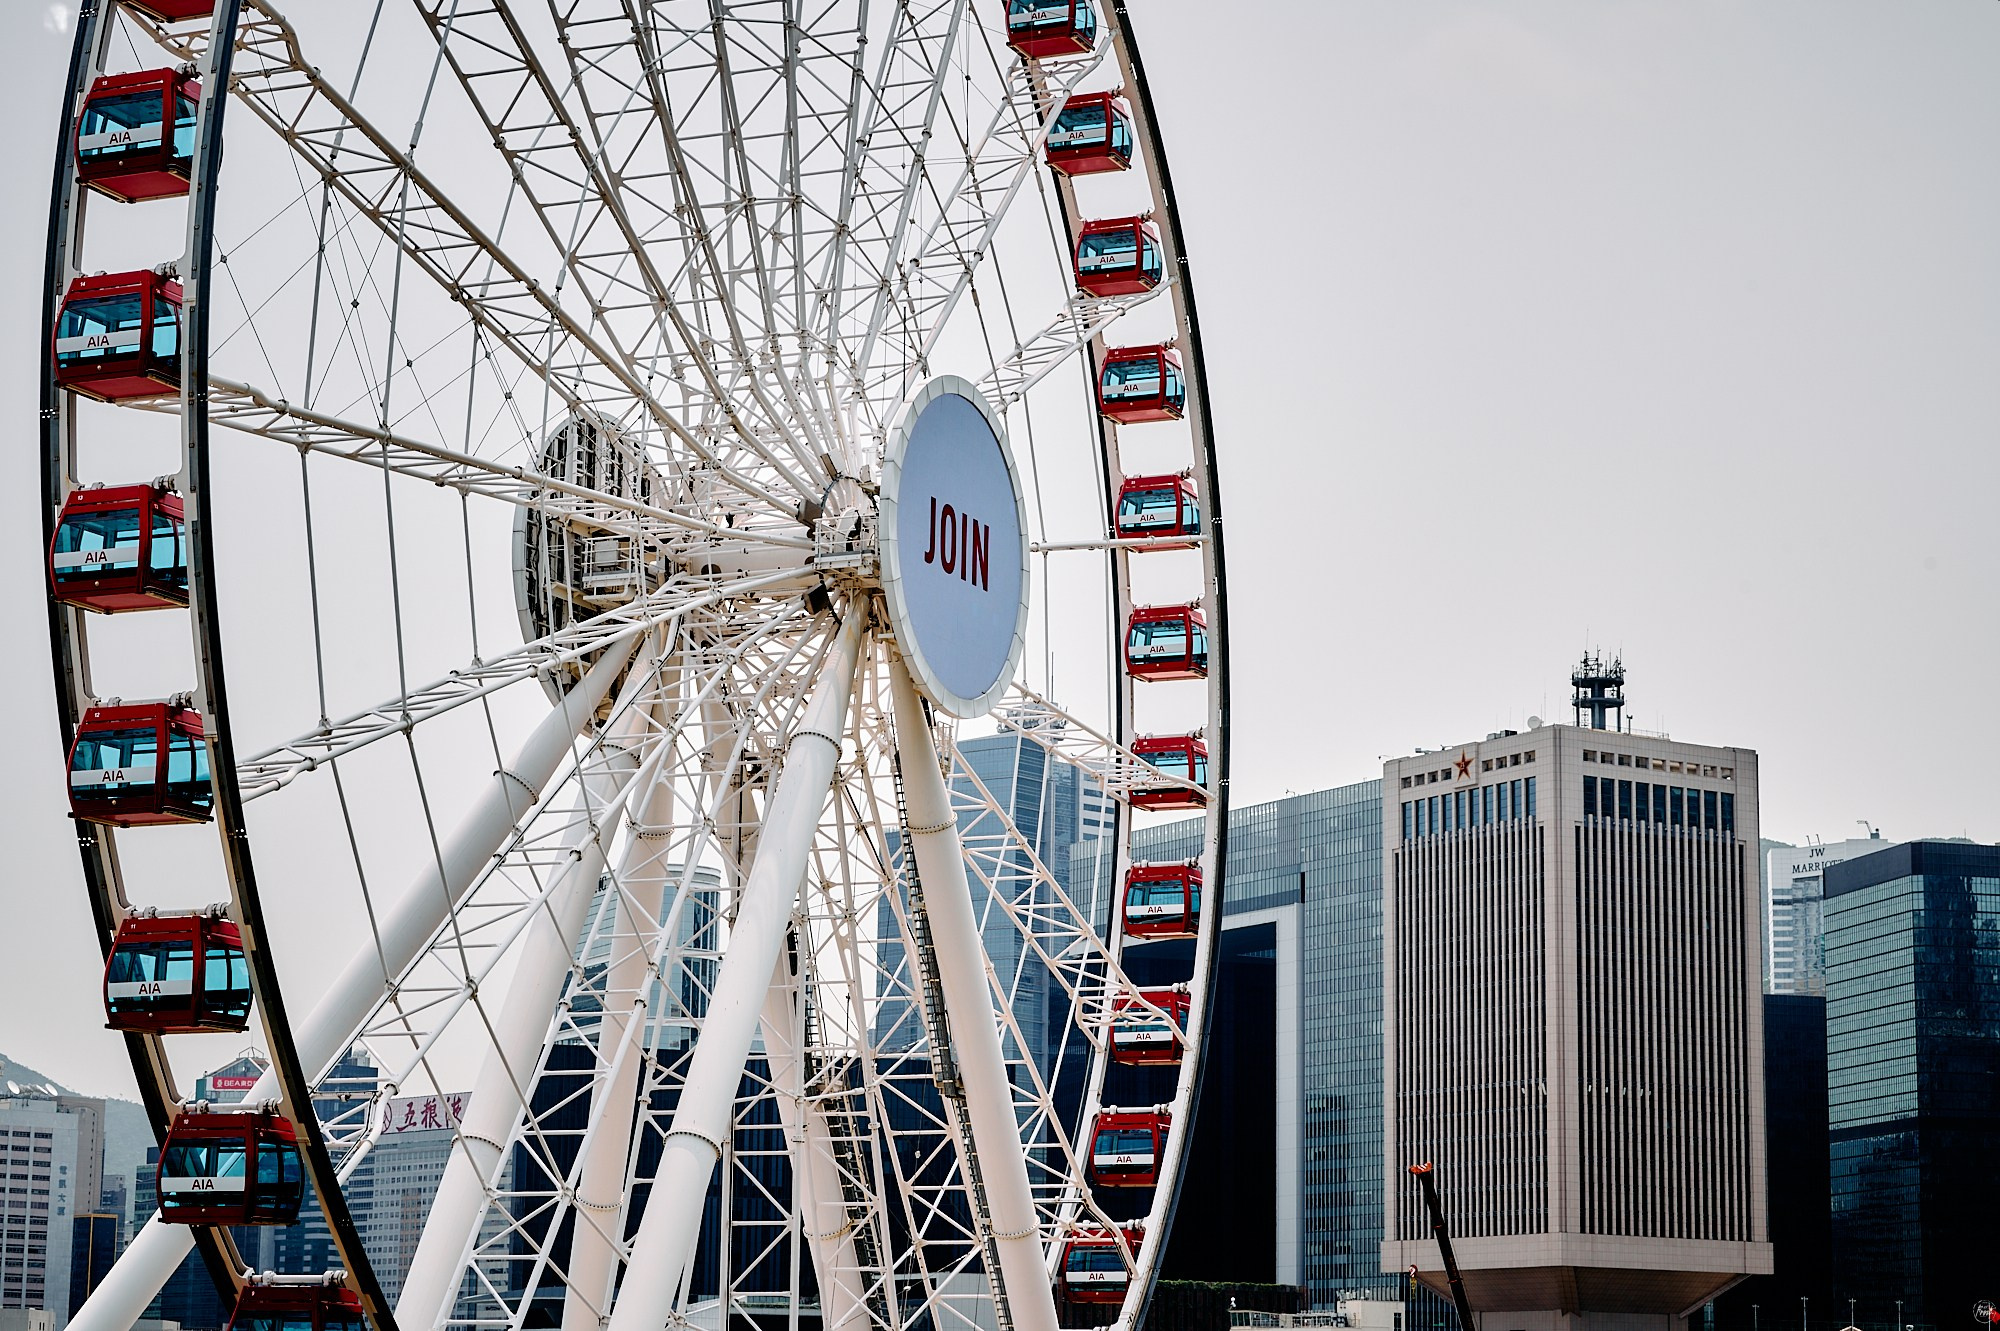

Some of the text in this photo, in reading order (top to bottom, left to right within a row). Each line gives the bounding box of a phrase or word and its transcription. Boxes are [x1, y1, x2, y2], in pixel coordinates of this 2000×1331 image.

[1031, 11, 1047, 20] AIA
[109, 131, 131, 145] AIA
[1068, 131, 1085, 140] AIA
[1099, 255, 1116, 264] AIA
[87, 335, 110, 348] AIA
[1123, 384, 1139, 392] AIA
[1139, 513, 1156, 522] AIA
[924, 496, 989, 592] JOIN
[85, 551, 108, 564] AIA
[1149, 645, 1165, 653] AIA
[102, 769, 124, 783] AIA
[1809, 848, 1825, 858] JW
[1792, 858, 1844, 873] MARRIOT
[1147, 906, 1163, 914] AIA
[138, 982, 161, 995] AIA
[1135, 1033, 1152, 1041] AIA
[191, 1179, 214, 1191] AIA
[1088, 1273, 1105, 1281] AIA
